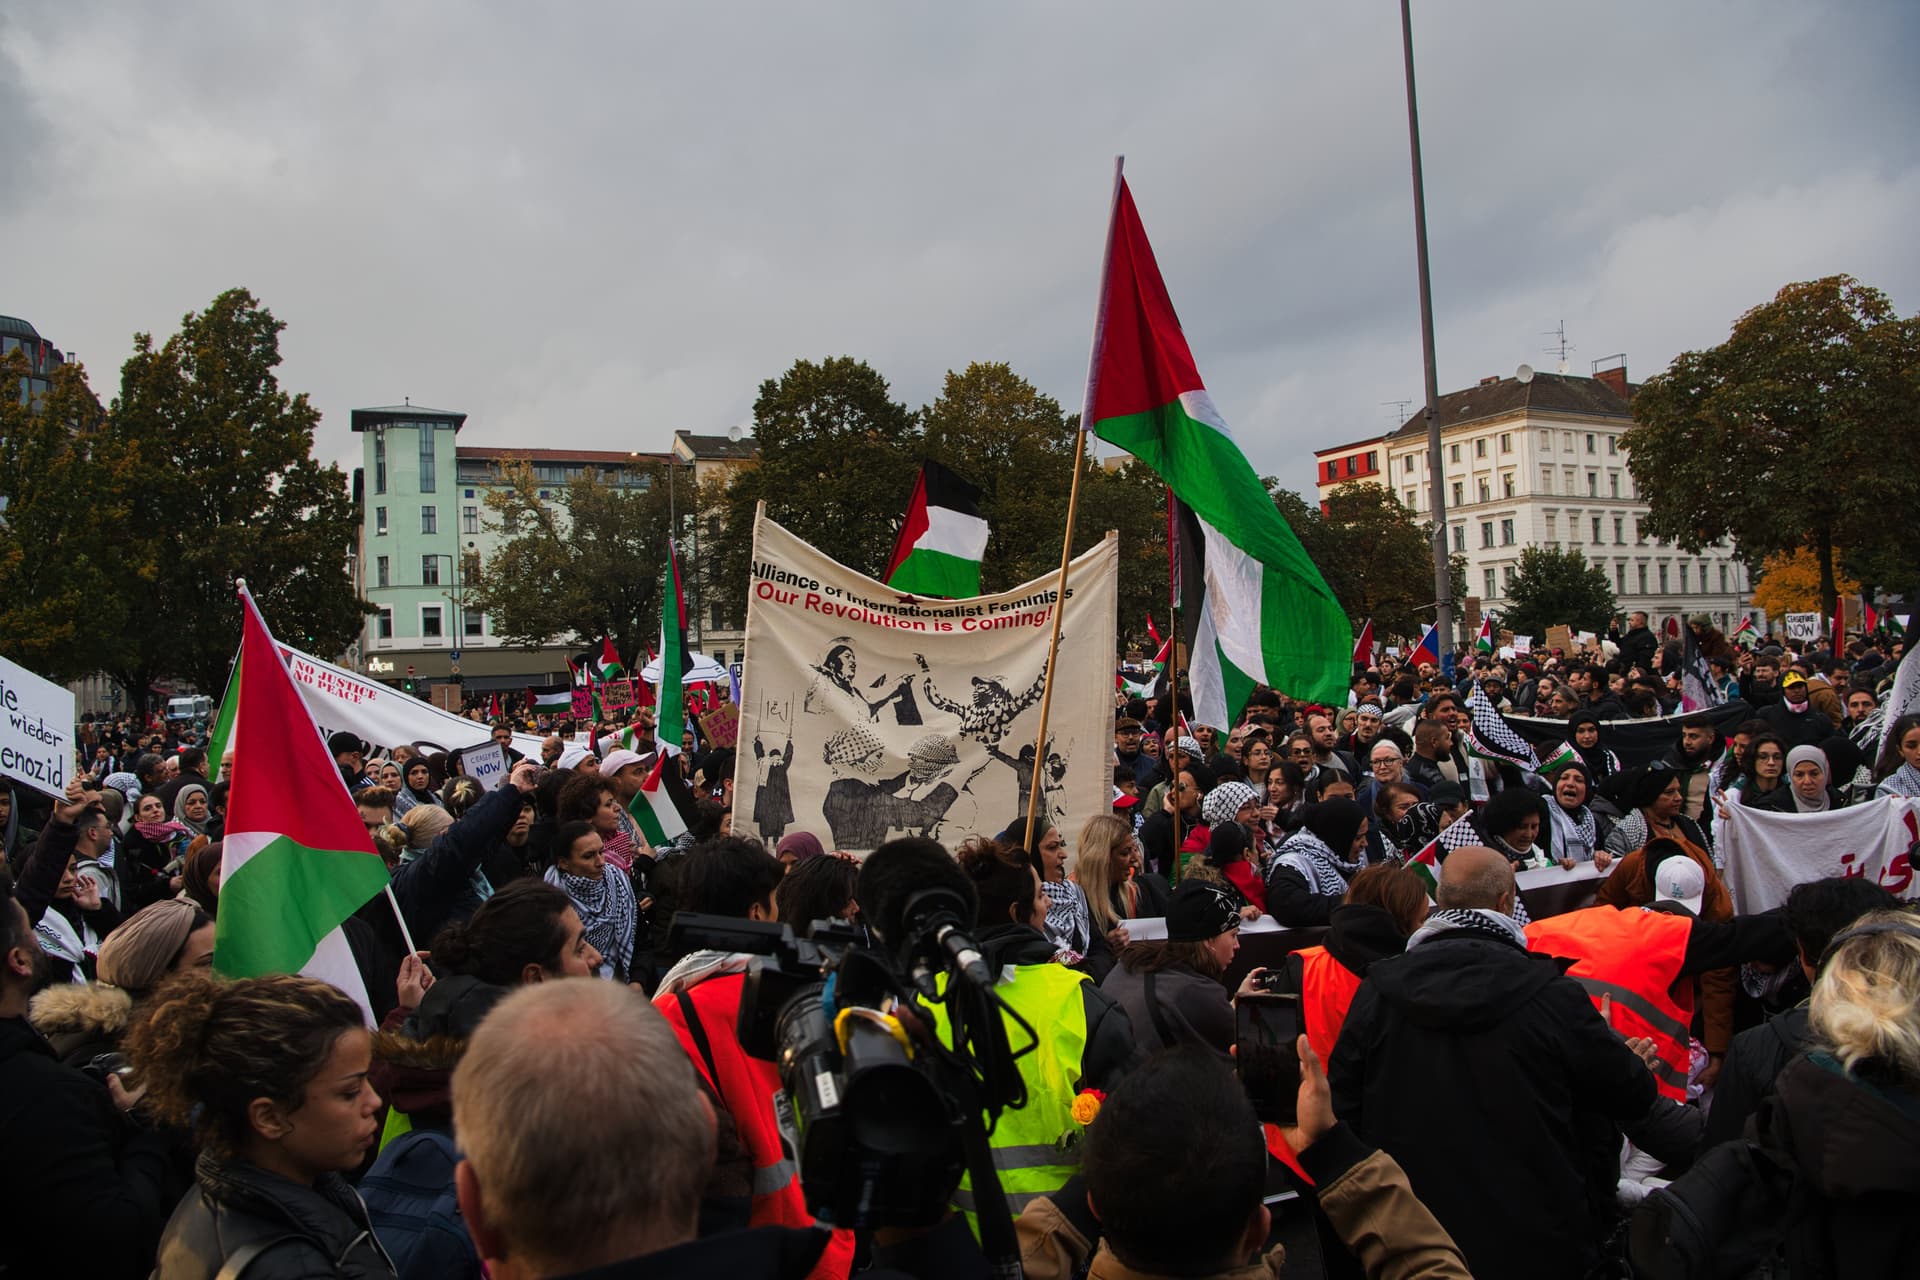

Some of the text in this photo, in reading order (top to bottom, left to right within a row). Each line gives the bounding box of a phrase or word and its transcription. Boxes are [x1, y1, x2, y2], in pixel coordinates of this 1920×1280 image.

[751, 560, 1074, 618] Alliance of Internationalist Feminiss
[757, 582, 1054, 632] Our Revolution is Coming!
[1788, 623, 1814, 637] NOW
[293, 669, 363, 705] NO PEACE
[295, 660, 378, 701] NO JUSTICE
[9, 713, 63, 747] wieder
[706, 711, 727, 729] LET
[716, 728, 738, 747] LIV
[0, 747, 63, 790] enozid
[475, 760, 501, 778] NOW
